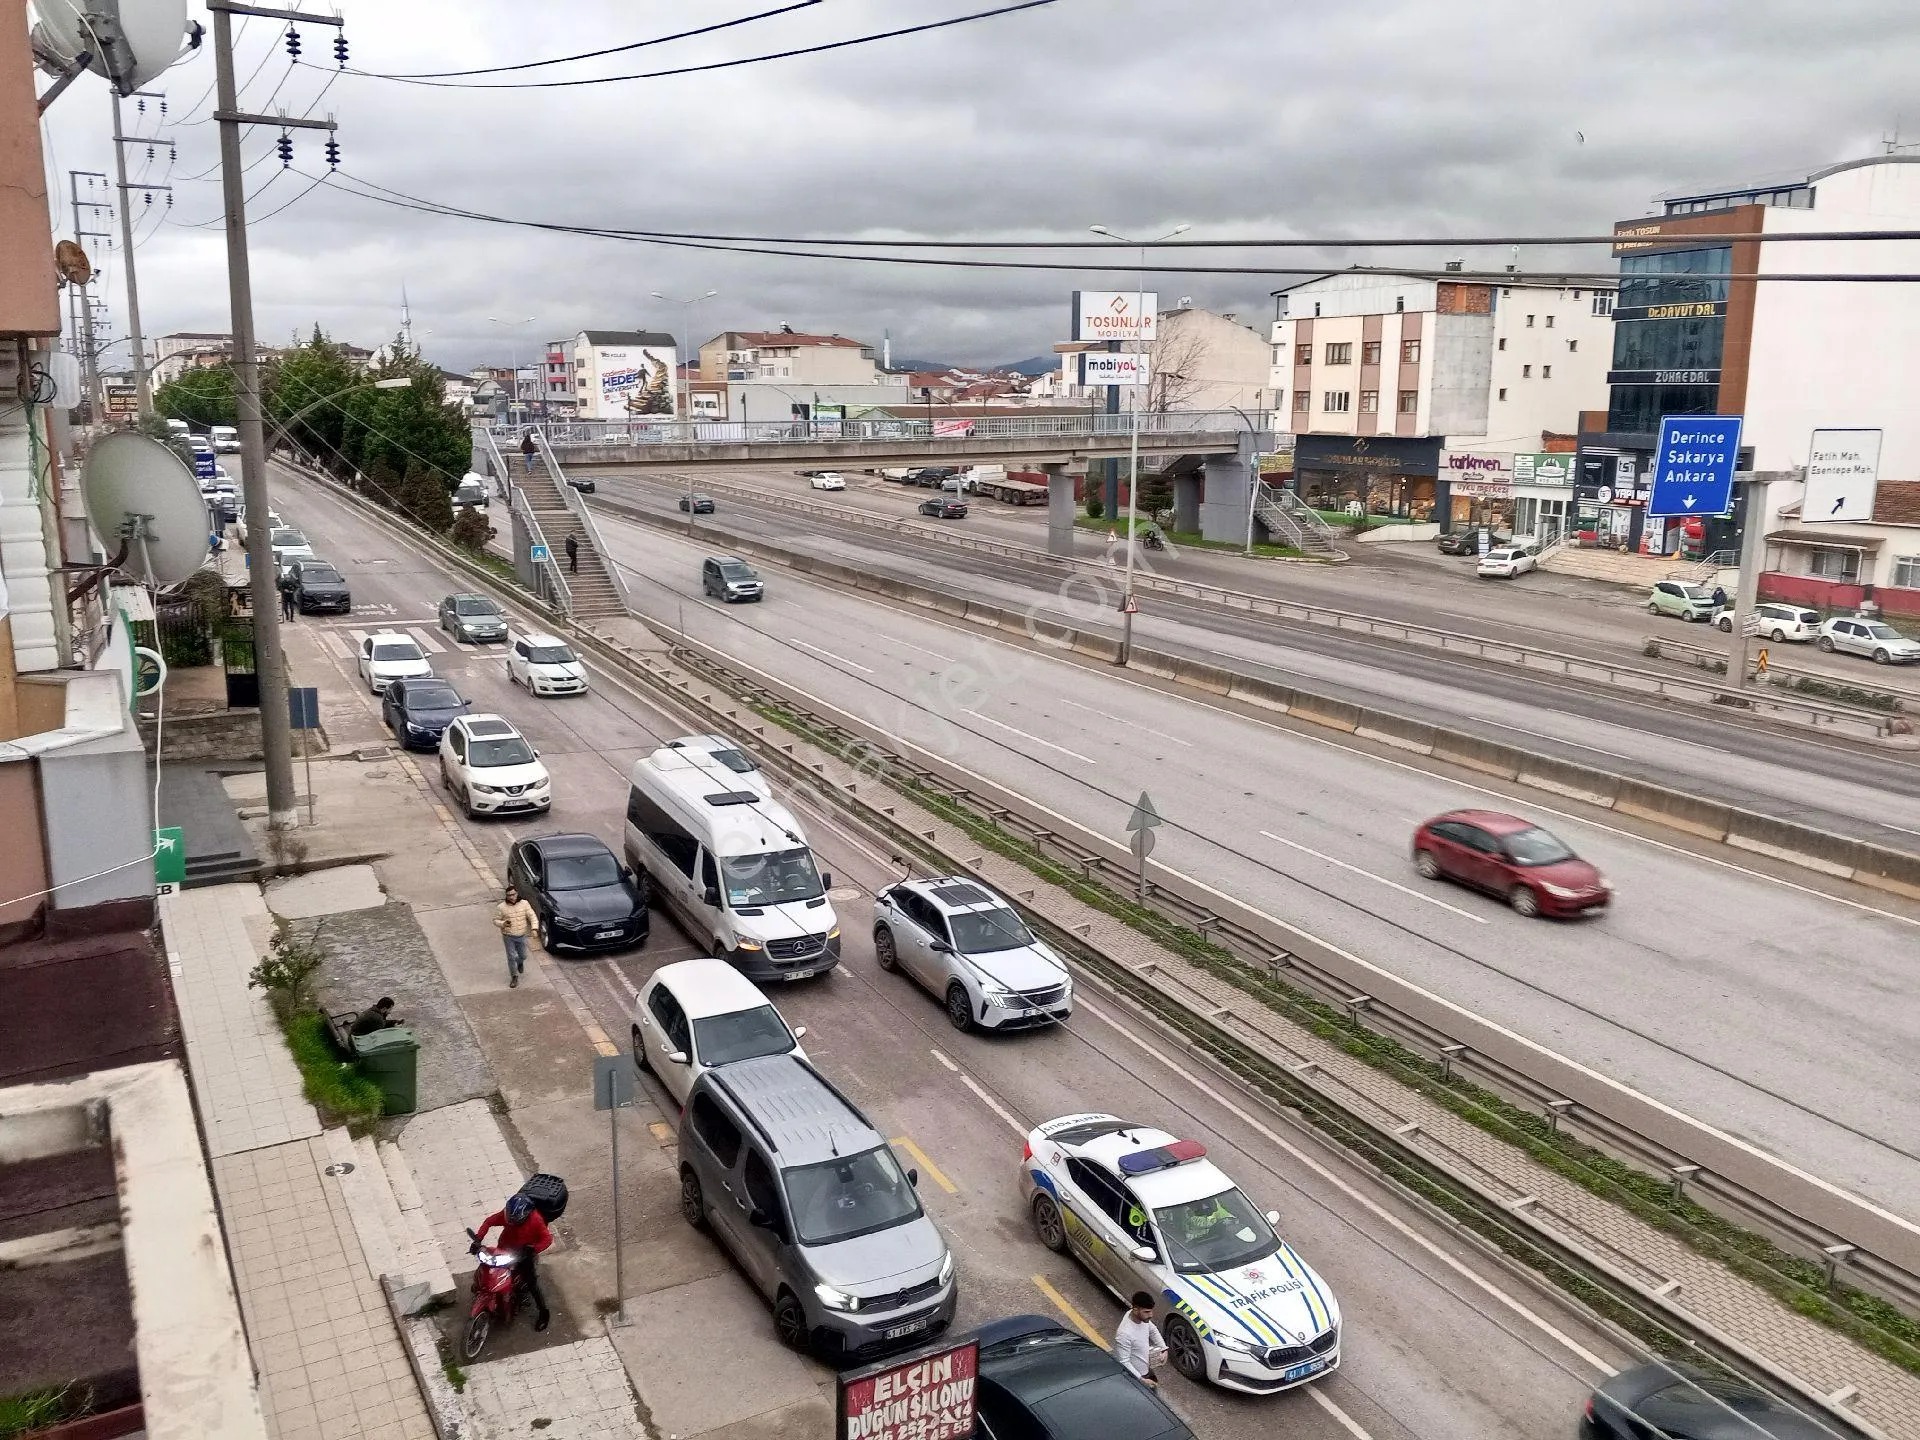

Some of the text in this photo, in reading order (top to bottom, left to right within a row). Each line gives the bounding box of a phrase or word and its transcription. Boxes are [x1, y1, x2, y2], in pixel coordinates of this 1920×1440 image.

[1696, 304, 1715, 315] DAL
[1085, 316, 1152, 328] TOSUNLAR
[602, 373, 638, 387] HEDEF
[1690, 371, 1710, 382] DAL
[1671, 431, 1725, 444] Derince
[1668, 450, 1724, 466] Sakarya
[1813, 452, 1838, 461] Fatih
[1664, 470, 1715, 482] Ankara
[1811, 465, 1852, 476] Esentepe
[1230, 1278, 1305, 1309] TRAFİK POLİSİ
[873, 1354, 952, 1404] ELÇİN
